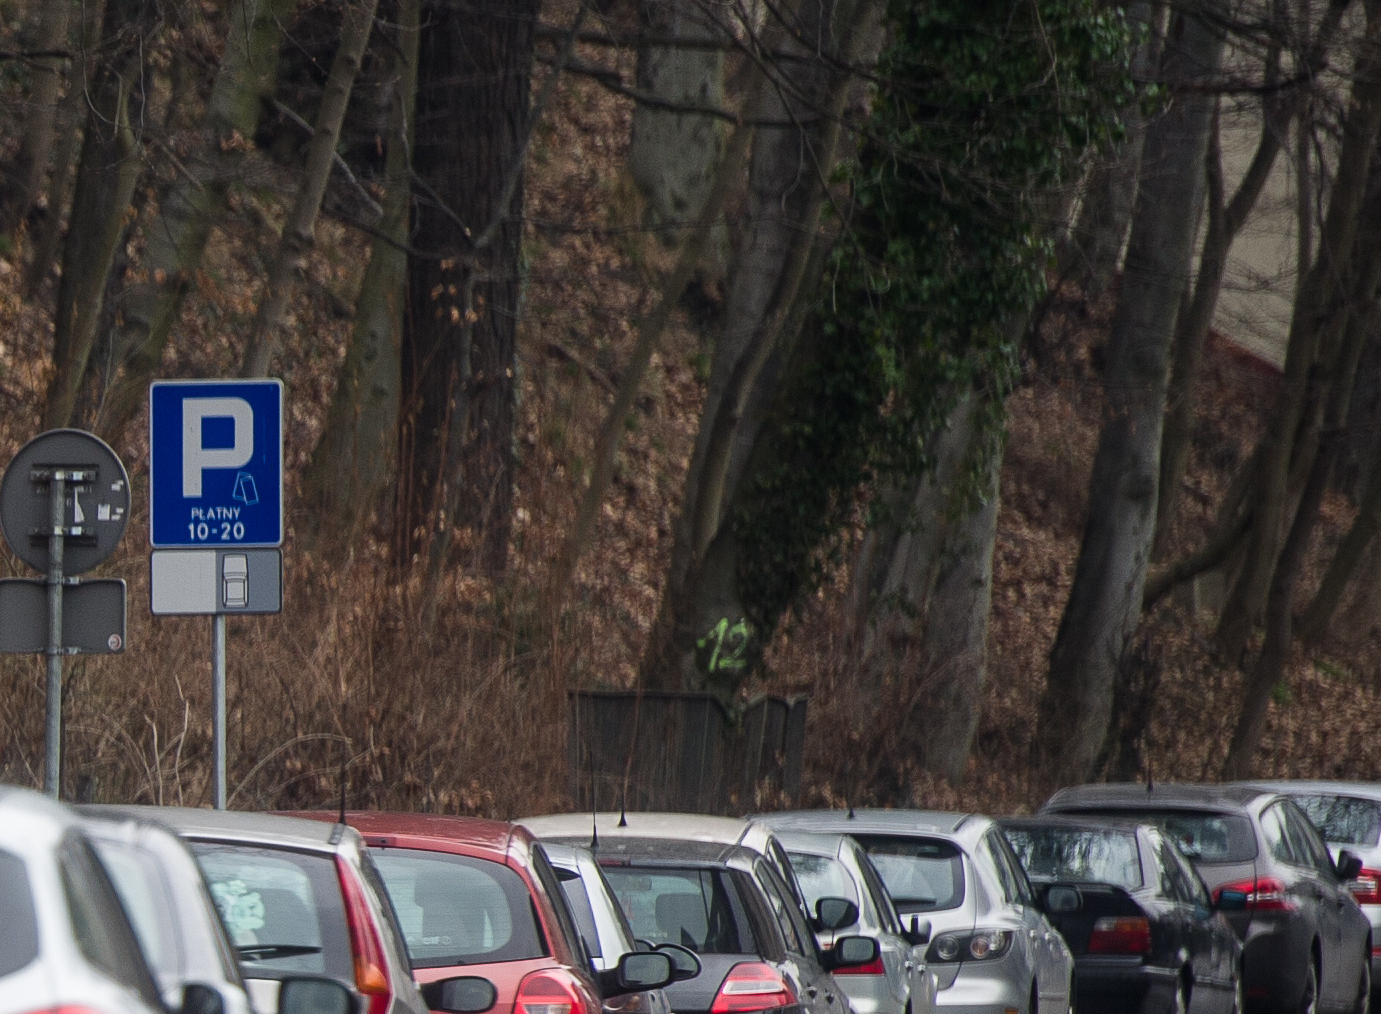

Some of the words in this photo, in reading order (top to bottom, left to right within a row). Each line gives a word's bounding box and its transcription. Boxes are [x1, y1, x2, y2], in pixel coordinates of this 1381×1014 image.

[182, 397, 254, 498] P
[188, 521, 245, 541] 10-20
[191, 506, 241, 521] PŁATNY
[696, 617, 748, 673] 12
